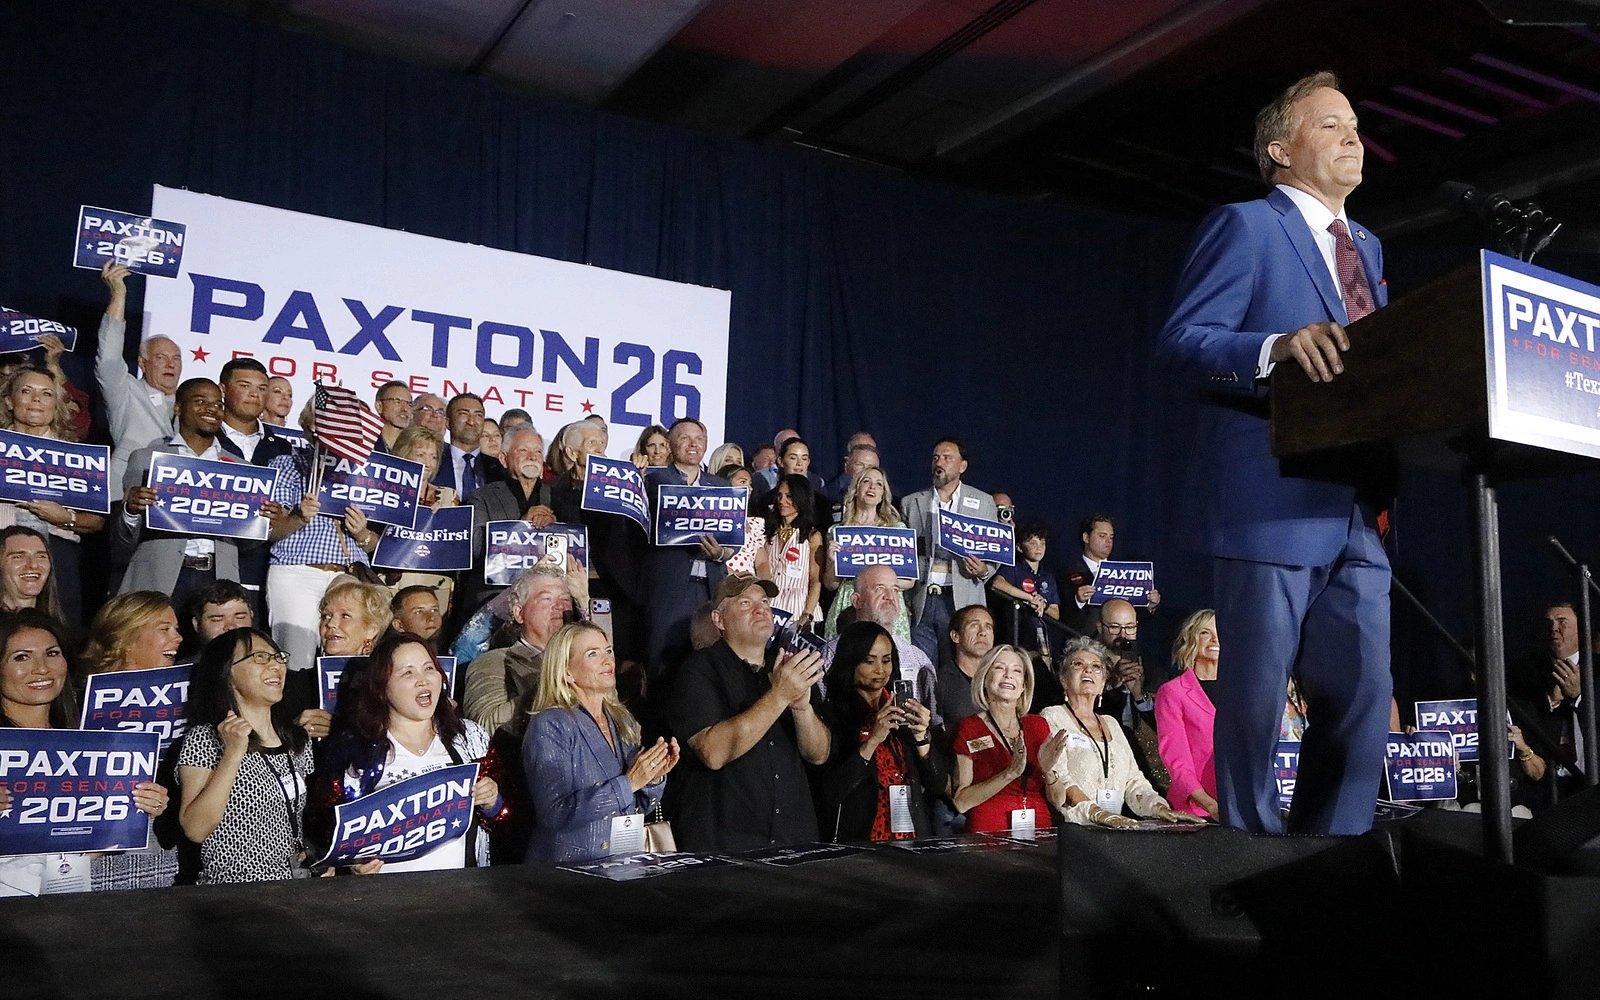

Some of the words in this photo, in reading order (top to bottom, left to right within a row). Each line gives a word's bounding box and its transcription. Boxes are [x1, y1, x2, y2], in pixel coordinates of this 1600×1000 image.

[85, 216, 183, 246] PAXTON
[10, 319, 66, 335] 2026
[188, 272, 600, 388] PAXTON
[610, 342, 702, 430] 26
[1523, 338, 1561, 360] FOR
[371, 370, 564, 412] SENATE
[5, 468, 88, 493] 2026
[156, 465, 273, 495] PAXTON
[319, 454, 419, 489] PAXTON
[154, 483, 190, 496] FOR
[331, 483, 400, 509] 2026
[170, 496, 250, 519] 2026
[663, 495, 745, 511] PAXTON
[385, 525, 469, 542] #TexasFirst
[674, 517, 733, 532] 2026
[941, 514, 1013, 540] PAXTON
[491, 531, 585, 548] PAXTN
[838, 534, 914, 549] PAXTON
[952, 534, 1001, 553] 2026
[851, 553, 905, 566] 2026
[1099, 568, 1152, 581] PAXTON
[1103, 585, 1144, 597] 2026
[94, 681, 190, 710] PAXT
[93, 708, 143, 721] FOR
[1386, 742, 1453, 758] PAXTON
[0, 750, 155, 777] PAXTON
[60, 780, 154, 793] SENAT
[1401, 767, 1446, 784] 2026
[19, 795, 130, 824] 2026
[342, 778, 472, 841] PAXTON
[392, 799, 468, 835] SENATE
[354, 817, 447, 859] 2026
